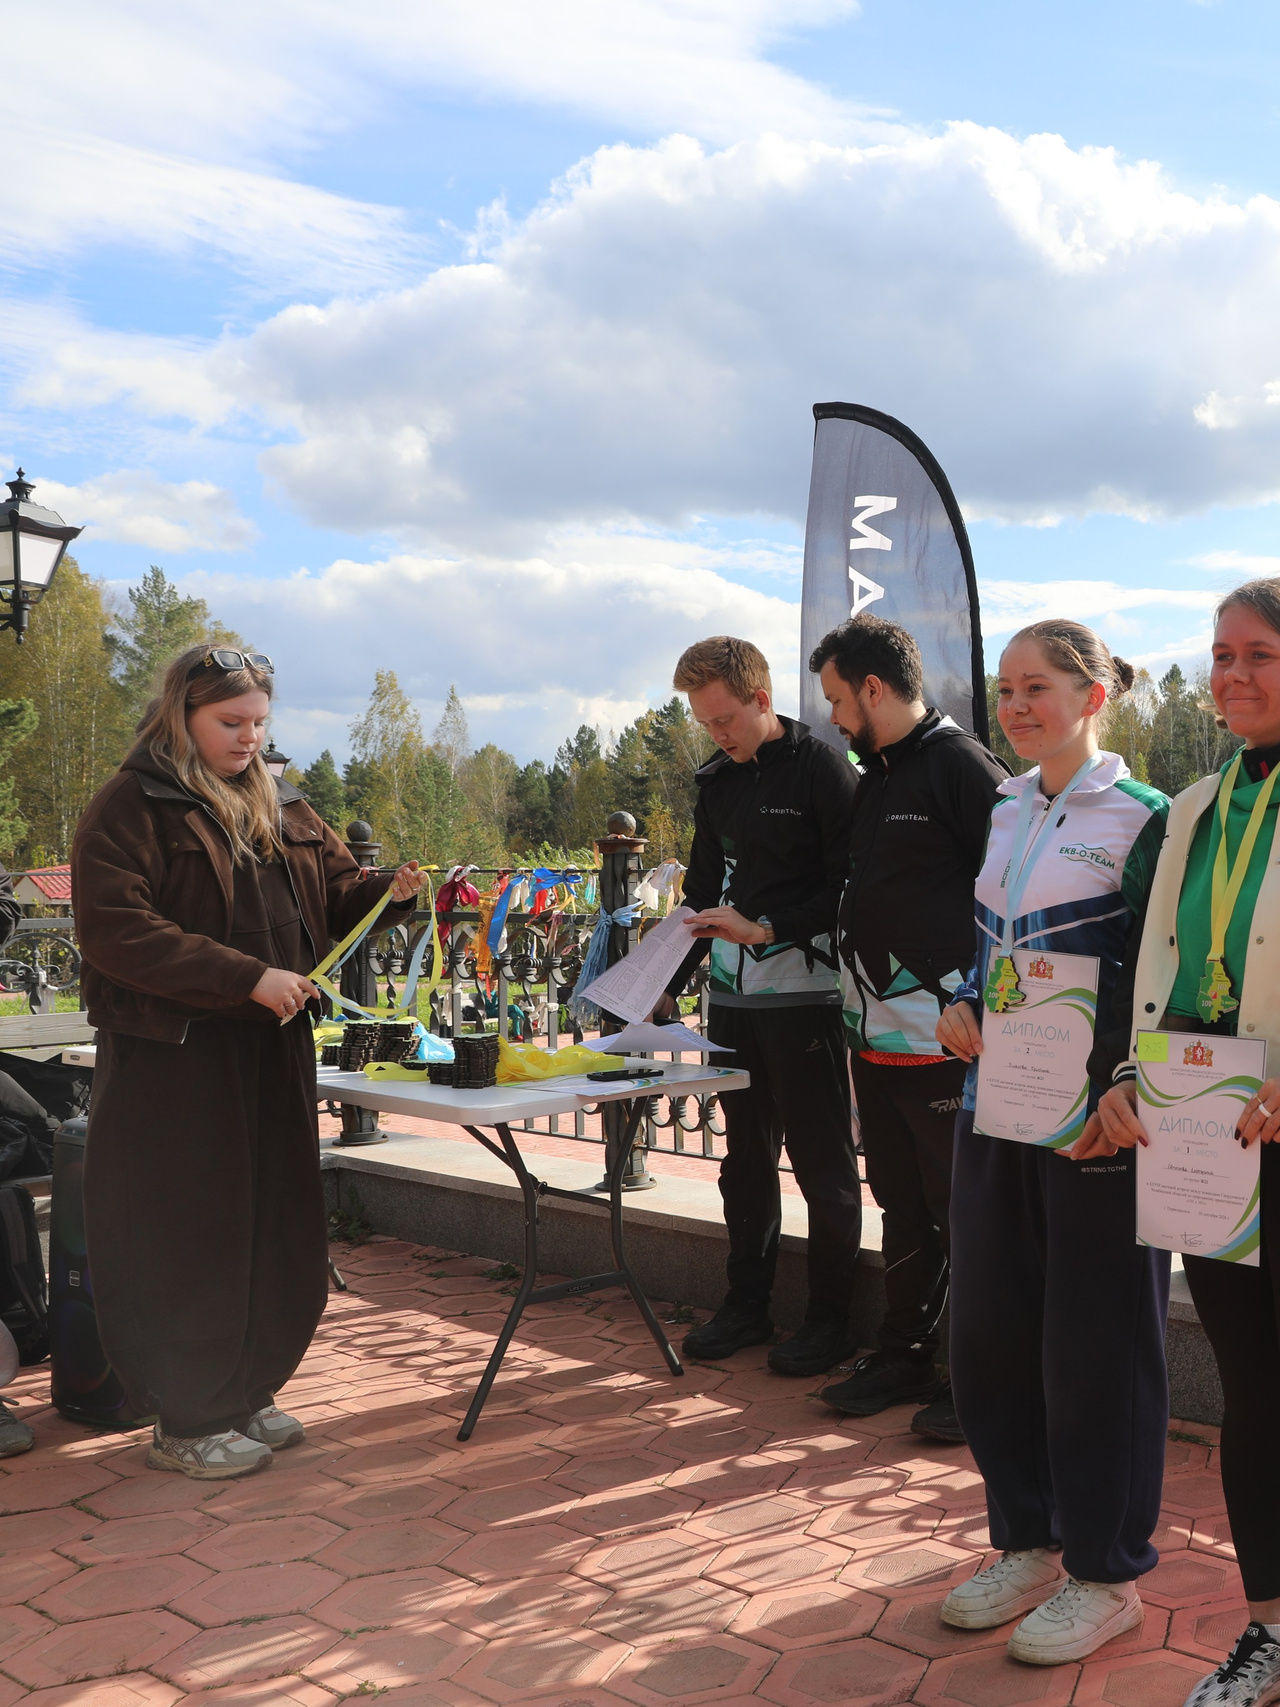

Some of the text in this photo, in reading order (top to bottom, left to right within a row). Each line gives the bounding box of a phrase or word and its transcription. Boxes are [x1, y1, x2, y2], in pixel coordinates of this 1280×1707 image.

[890, 814, 929, 822] ORIENTEAM
[1059, 846, 1115, 870] EKB-O-TEAM
[1002, 1021, 1071, 1042] ДИПЛОМ
[1159, 1116, 1235, 1139] ДИПЛОМ
[1196, 1149, 1218, 1158] МЕСТО
